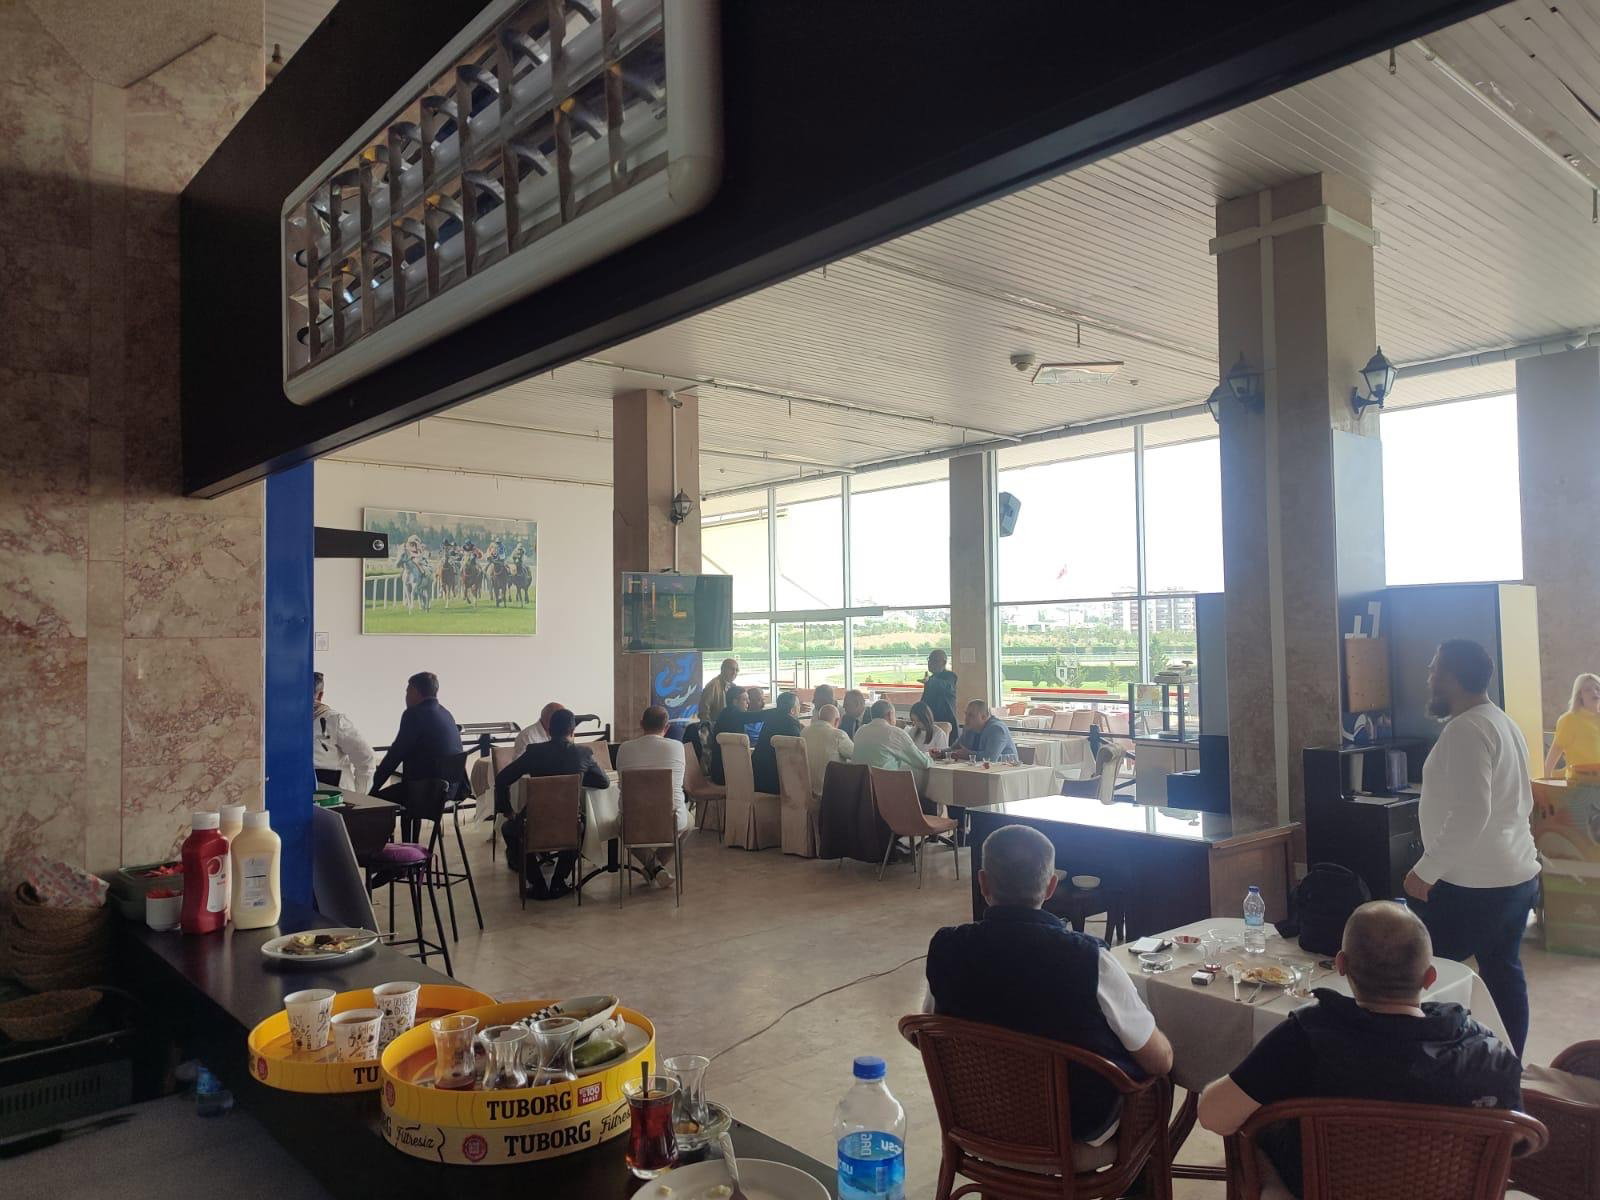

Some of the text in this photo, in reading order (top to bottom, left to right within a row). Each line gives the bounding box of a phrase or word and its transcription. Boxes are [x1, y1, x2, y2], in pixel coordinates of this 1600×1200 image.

[486, 1090, 572, 1120] TUBORG
[600, 1102, 631, 1134] Filtres
[504, 1120, 591, 1157] TUBORG
